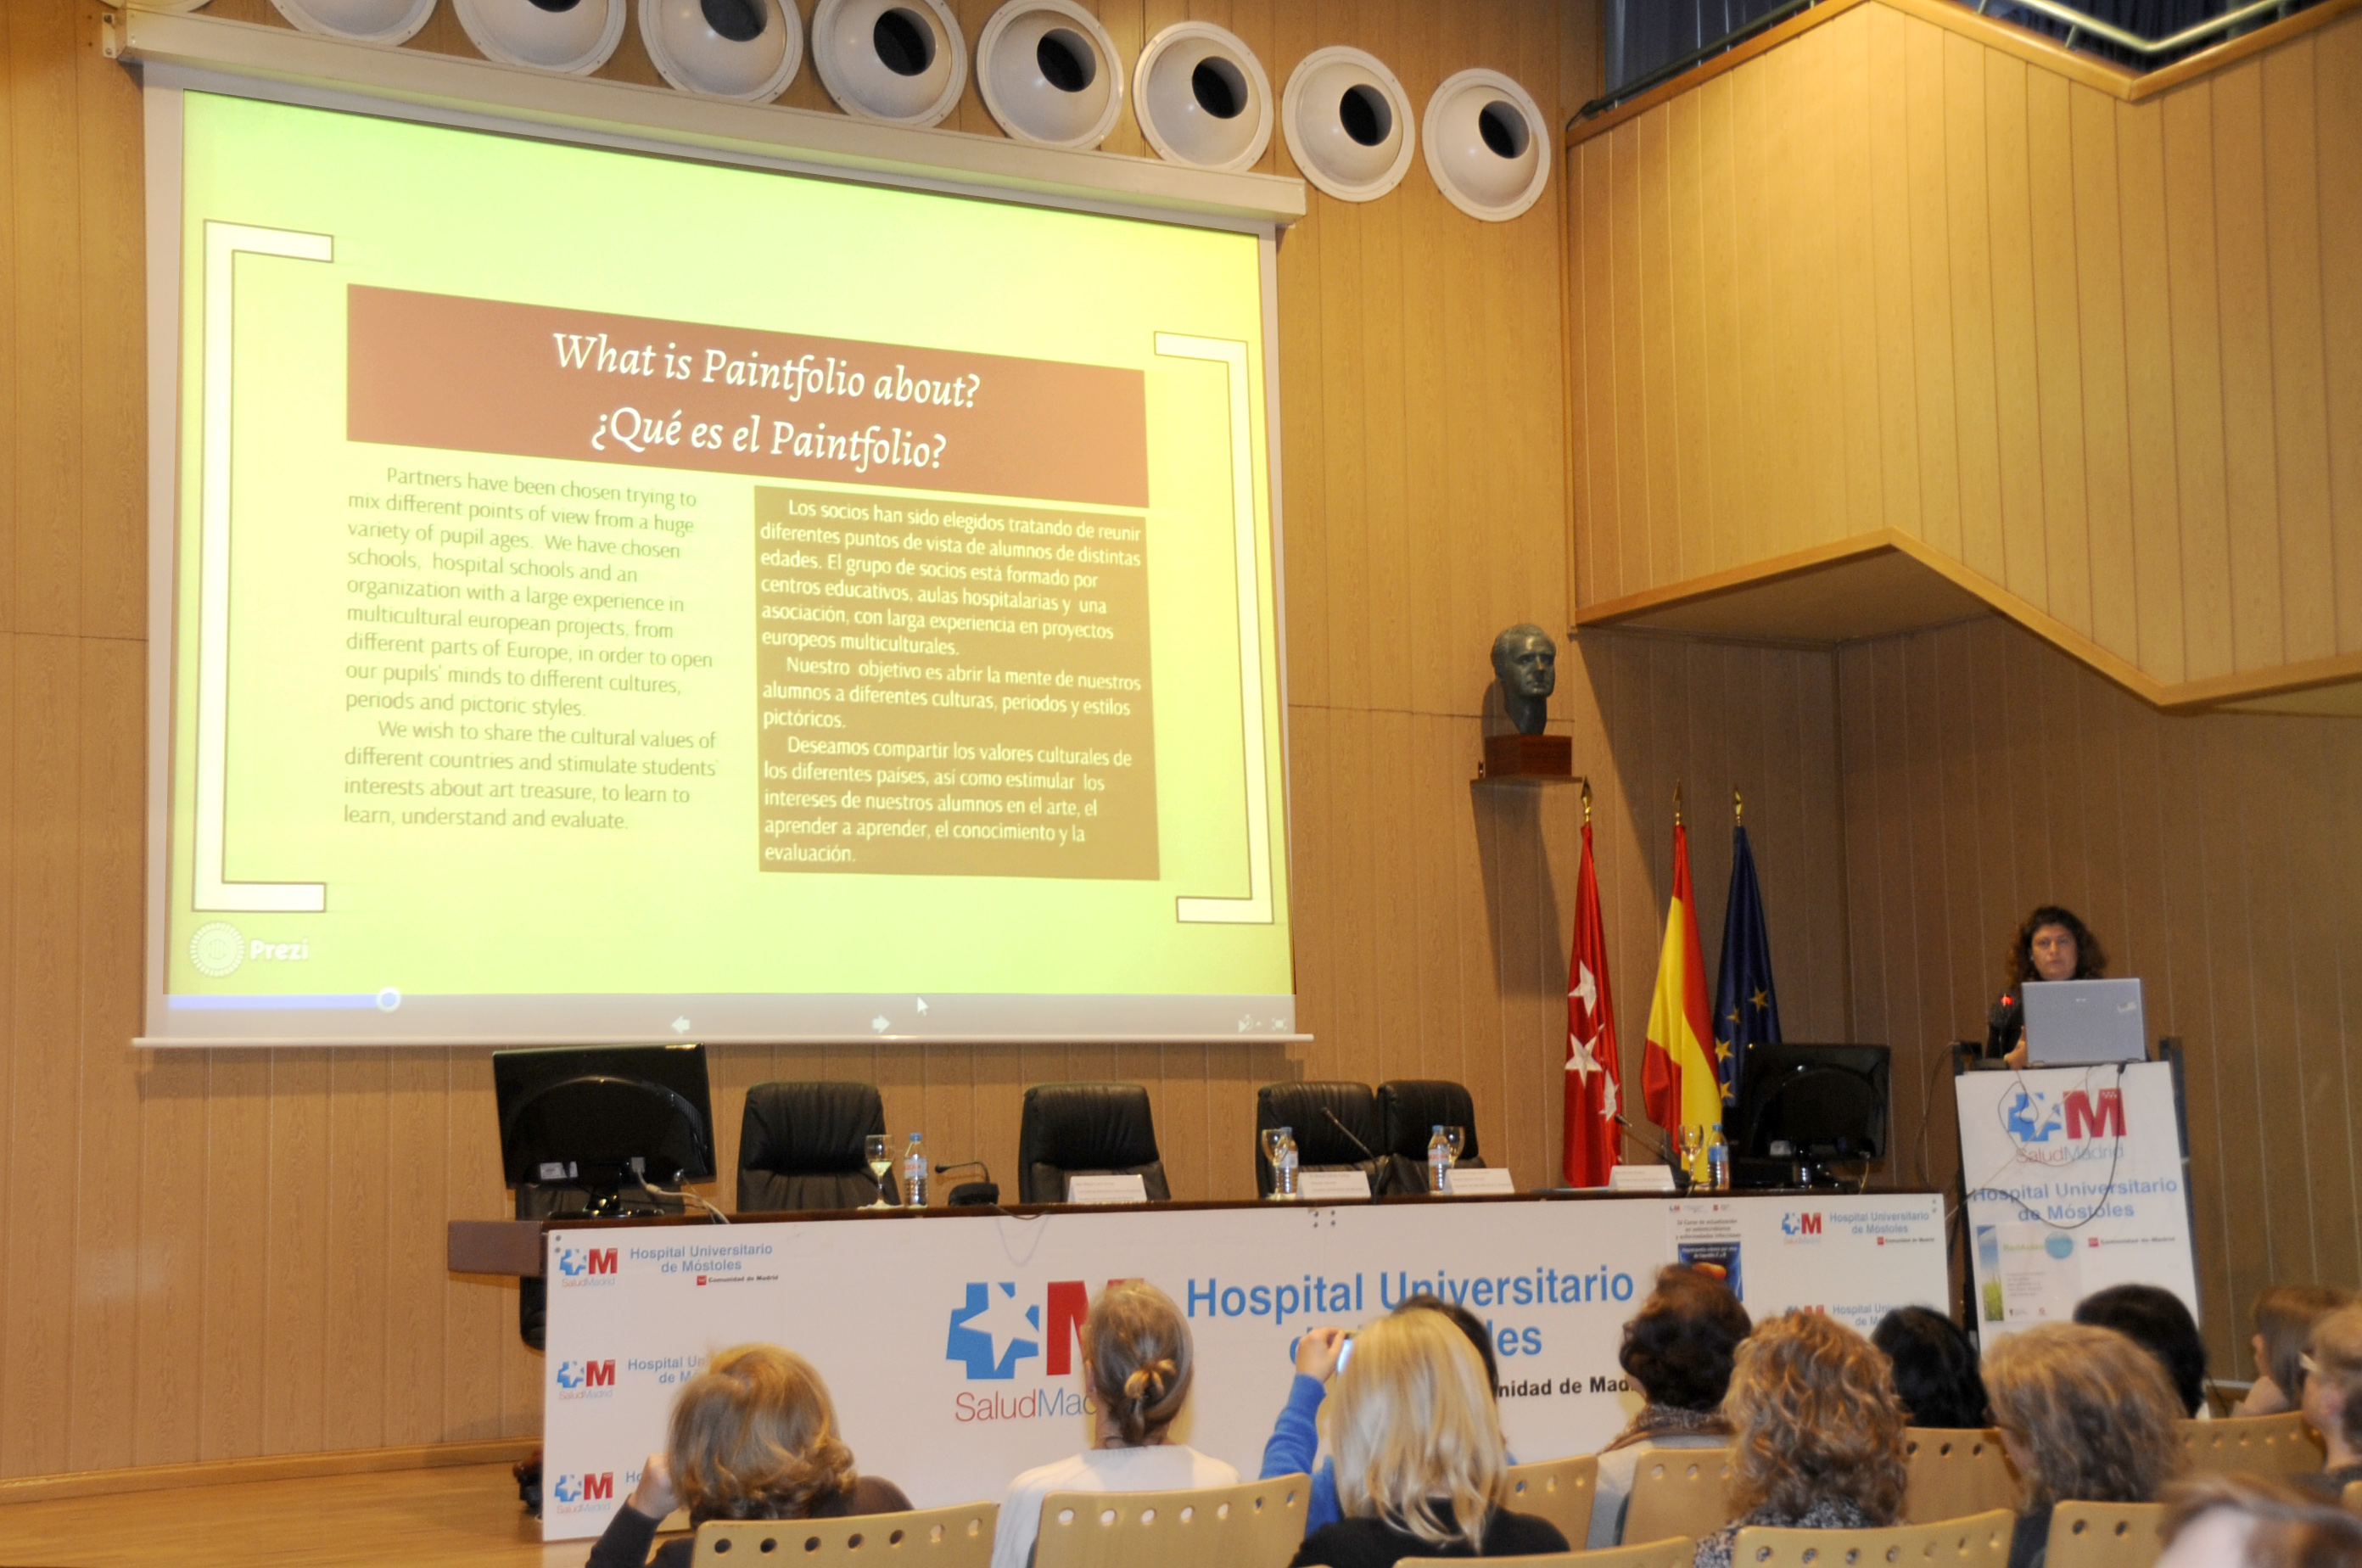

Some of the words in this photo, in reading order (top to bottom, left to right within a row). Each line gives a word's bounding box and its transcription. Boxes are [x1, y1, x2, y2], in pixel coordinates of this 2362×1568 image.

[553, 332, 656, 376] What
[664, 342, 693, 381] is
[702, 348, 865, 401] Paintfolio
[873, 365, 981, 409] about?
[591, 406, 682, 453] ¿Qué
[691, 422, 724, 451] es
[732, 415, 761, 453] el
[770, 421, 947, 473] Paintfolio?
[387, 467, 463, 489] Partners
[467, 472, 509, 492] have
[513, 475, 556, 496] been
[560, 479, 622, 501] chosen
[626, 487, 675, 511] trying
[679, 491, 697, 507] to
[348, 495, 380, 510] mix
[385, 493, 463, 516] different
[468, 504, 524, 522] points
[528, 504, 547, 522] of
[551, 511, 590, 525] view
[595, 508, 635, 529] from
[638, 517, 649, 530] a
[653, 513, 695, 538] huge
[788, 499, 817, 518] Los
[820, 504, 870, 521] socios
[873, 504, 904, 524] han
[906, 508, 940, 527] sido
[942, 511, 1005, 535] elegidos
[1008, 518, 1073, 537] tratando
[1075, 521, 1095, 539] de
[1098, 527, 1141, 540] reunir
[347, 524, 411, 546] variety
[415, 524, 434, 541] of
[439, 527, 484, 549] pupil
[489, 533, 534, 553] ages.
[544, 534, 573, 552] We
[576, 535, 618, 555] have
[620, 539, 681, 559] chosen
[760, 521, 842, 545] diferentes
[844, 532, 900, 550] puntos
[902, 532, 923, 551] de
[925, 538, 963, 554] vista
[966, 538, 986, 555] de
[988, 540, 1053, 560] alumnos
[1055, 544, 1075, 562] de
[1077, 546, 1141, 567] distintas
[347, 547, 421, 570] schools,
[432, 552, 504, 577] hospital
[509, 558, 575, 580] schools
[579, 563, 612, 581] and
[616, 569, 638, 583] an
[760, 549, 823, 569] edades.
[827, 553, 842, 570] El
[845, 558, 893, 578] grupo
[894, 557, 916, 576] de
[918, 562, 967, 580] socios
[970, 566, 1003, 582] está
[1006, 565, 1071, 586] formado
[1073, 574, 1099, 591] por
[346, 579, 462, 600] organization
[466, 584, 506, 602] with
[509, 589, 521, 603] a
[526, 585, 569, 611] large
[573, 593, 665, 613] experience
[669, 600, 685, 613] in
[761, 578, 822, 596] centros
[824, 579, 914, 602] educativos,
[916, 586, 960, 605] aulas
[962, 587, 1060, 611] hospitalarias
[1061, 598, 1072, 616] y
[1078, 600, 1107, 614] una
[346, 604, 462, 627] multicultural
[467, 614, 551, 635] european
[556, 619, 630, 640] projects,
[635, 619, 674, 639] from
[762, 605, 850, 624] asociación,
[854, 610, 883, 625] con
[887, 608, 926, 632] larga
[929, 615, 1016, 634] experiencia
[1018, 621, 1039, 635] en
[1042, 622, 1115, 642] proyectos
[345, 631, 425, 653] different
[430, 640, 479, 659] parts
[482, 638, 501, 657] of
[507, 641, 573, 664] Europe,
[578, 648, 594, 662] in
[598, 646, 644, 664] order
[649, 650, 667, 666] to
[670, 653, 714, 672] open
[762, 631, 837, 652] europeos
[840, 632, 960, 656] multiculturales.
[786, 656, 851, 675] Nuestro
[858, 659, 922, 682] objetivo
[925, 667, 943, 680] es
[946, 664, 984, 682] abrir
[987, 665, 1001, 684] la
[1005, 670, 1053, 686] mente
[1055, 669, 1074, 687] de
[1077, 675, 1142, 692] nuestros
[345, 691, 415, 713] periods
[419, 693, 455, 712] and
[460, 697, 527, 716] pictoric
[532, 697, 586, 720] styles.
[764, 710, 847, 730] pictóricos.
[344, 804, 395, 826] learn,
[401, 807, 507, 826] understand
[512, 809, 546, 827] and
[550, 809, 629, 830] evaluate.
[250, 938, 309, 960] Prezi
[2016, 1145, 2124, 1164] SaludMadrid
[1973, 1184, 2049, 1204] Hospital
[2056, 1177, 2178, 1198] Universitario
[1829, 1212, 1868, 1224] Hospital
[1871, 1210, 1929, 1223] Universitario
[2018, 1207, 2040, 1222] de
[2047, 1202, 2135, 1220] Móstoles
[1851, 1225, 1864, 1235] de
[630, 1246, 686, 1261] Hospital
[690, 1243, 773, 1257] Universitario
[661, 1261, 678, 1273] de
[682, 1259, 742, 1273] Móstoles
[1187, 1272, 1363, 1325] Hospital
[1380, 1264, 1634, 1310] Universitario
[1833, 1304, 1872, 1315] Hospital
[1855, 1317, 1867, 1327] de
[627, 1358, 683, 1372] Hospital
[658, 1372, 675, 1384] de
[1559, 1377, 1582, 1395] de
